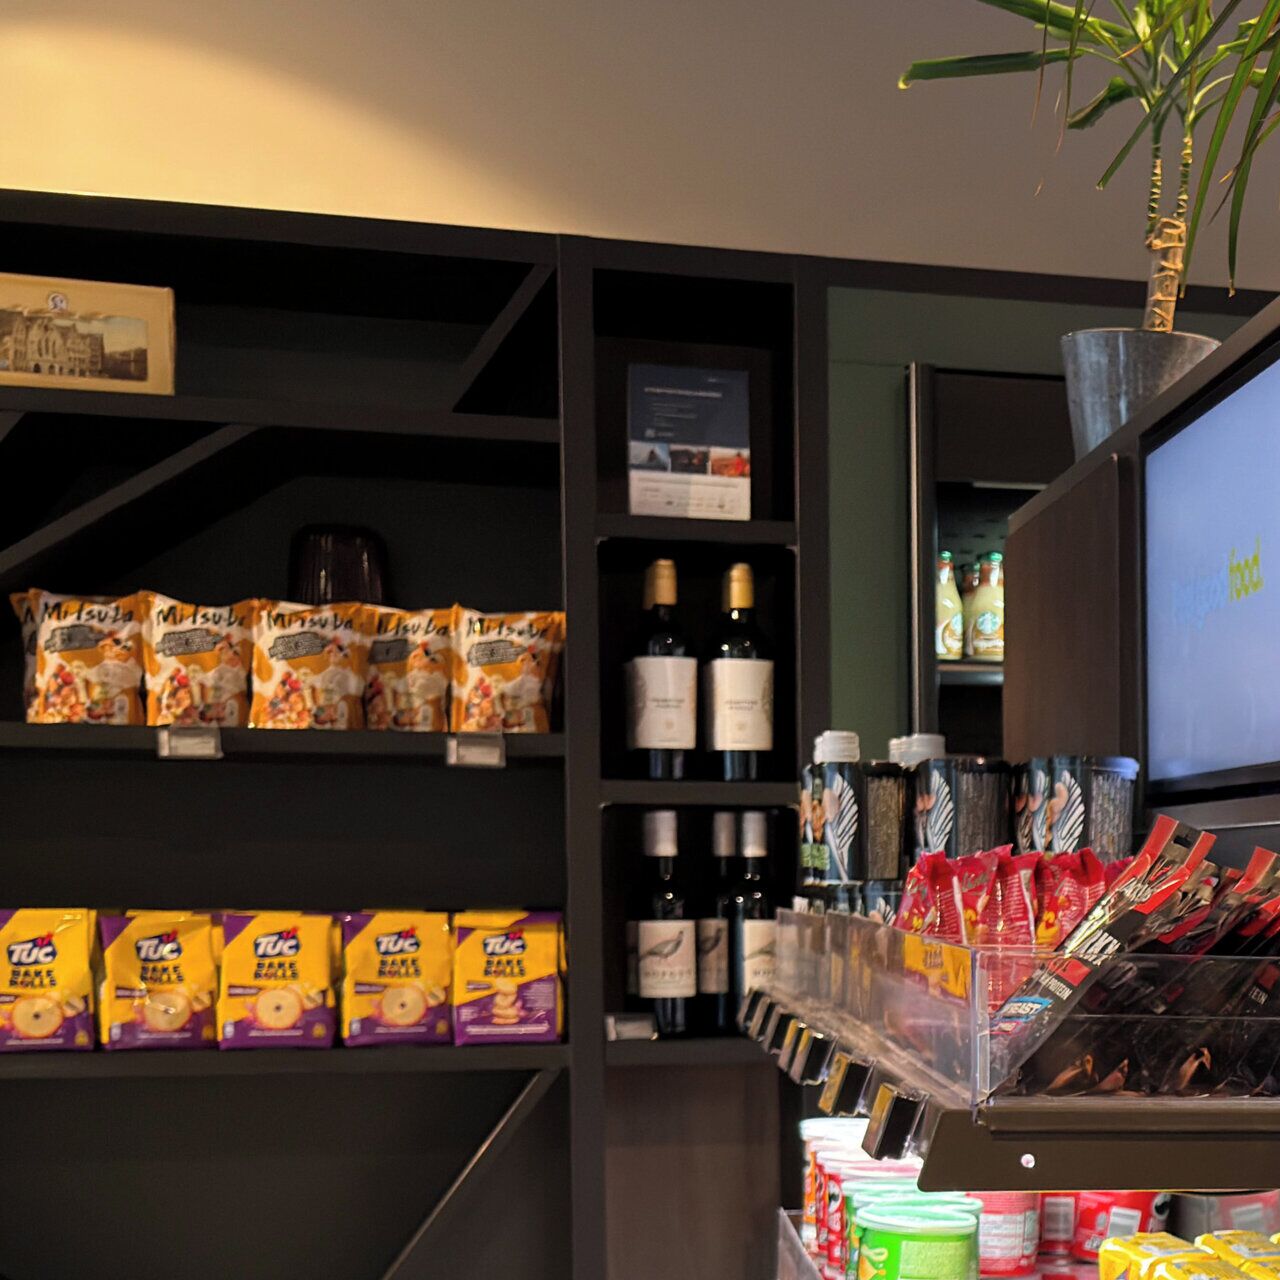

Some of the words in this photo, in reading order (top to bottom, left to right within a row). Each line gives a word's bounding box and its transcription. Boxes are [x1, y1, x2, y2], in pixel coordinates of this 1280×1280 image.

[9, 942, 55, 965] TUC
[137, 938, 181, 962] TUC
[255, 937, 300, 958] TUC
[376, 935, 420, 956] TUC
[483, 935, 526, 957] TUC
